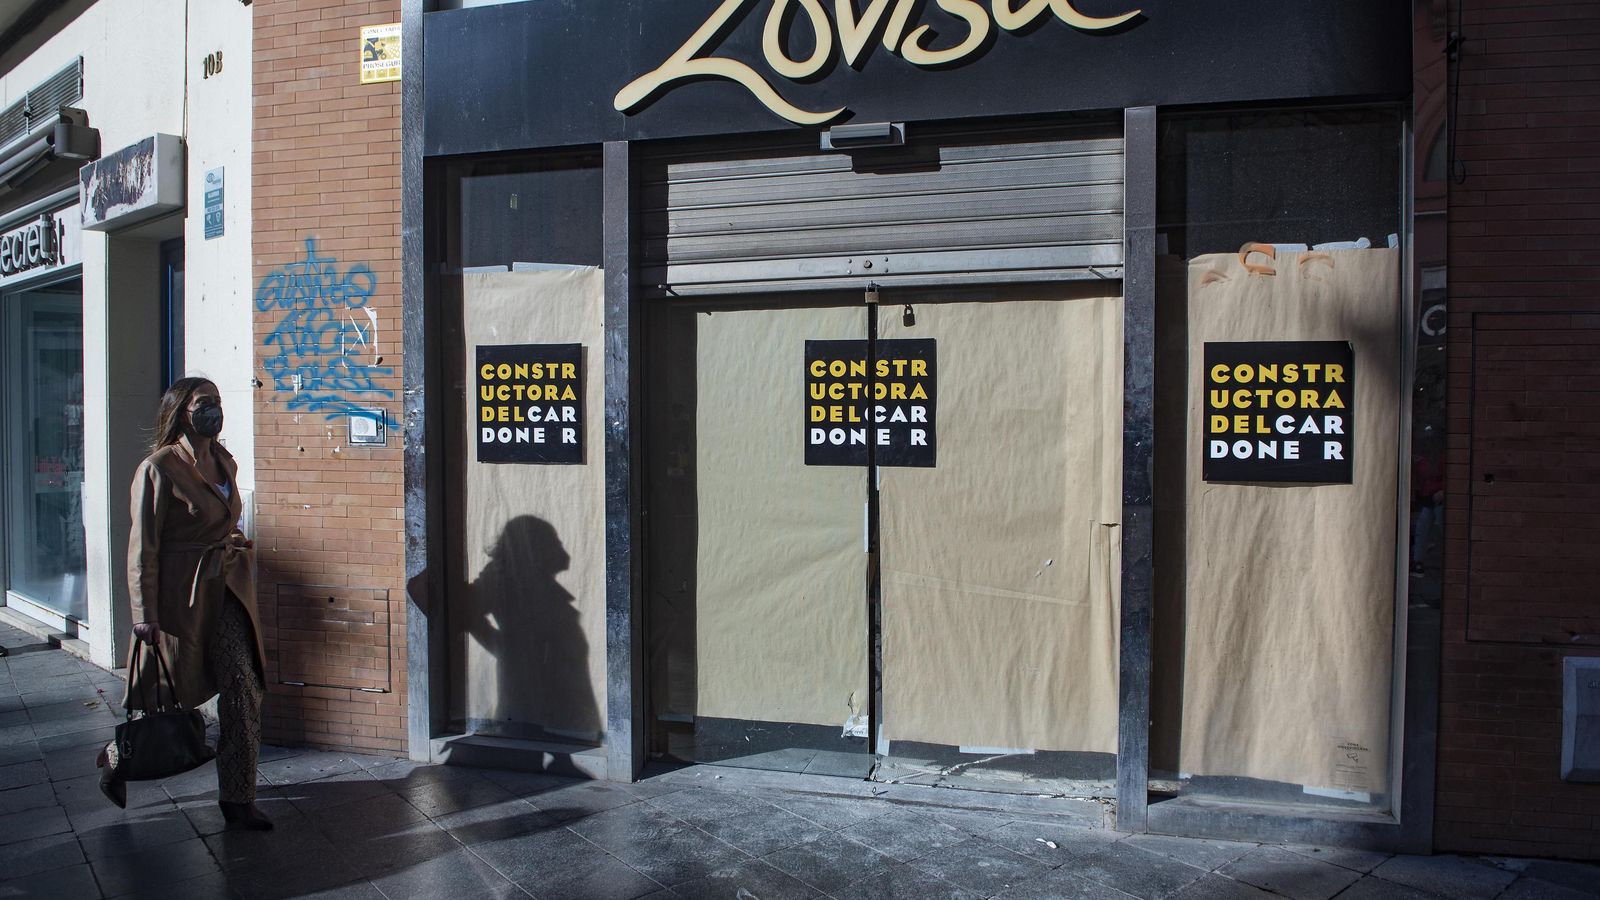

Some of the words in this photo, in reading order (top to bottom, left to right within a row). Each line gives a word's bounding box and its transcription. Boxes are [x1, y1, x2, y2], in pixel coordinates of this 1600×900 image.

[203, 50, 223, 80] 10B
[480, 362, 577, 380] CONSTR
[810, 359, 928, 378] CONSTR
[1210, 363, 1345, 384] CONSTR
[480, 384, 577, 401] UCTORA
[810, 382, 929, 400] UCTORA
[1210, 388, 1345, 409] UCTORA
[481, 426, 545, 444] DONE
[562, 427, 577, 444] R
[810, 427, 891, 446] DONE
[910, 428, 928, 446] R
[1210, 439, 1300, 460] DONE
[1323, 440, 1344, 460] R
